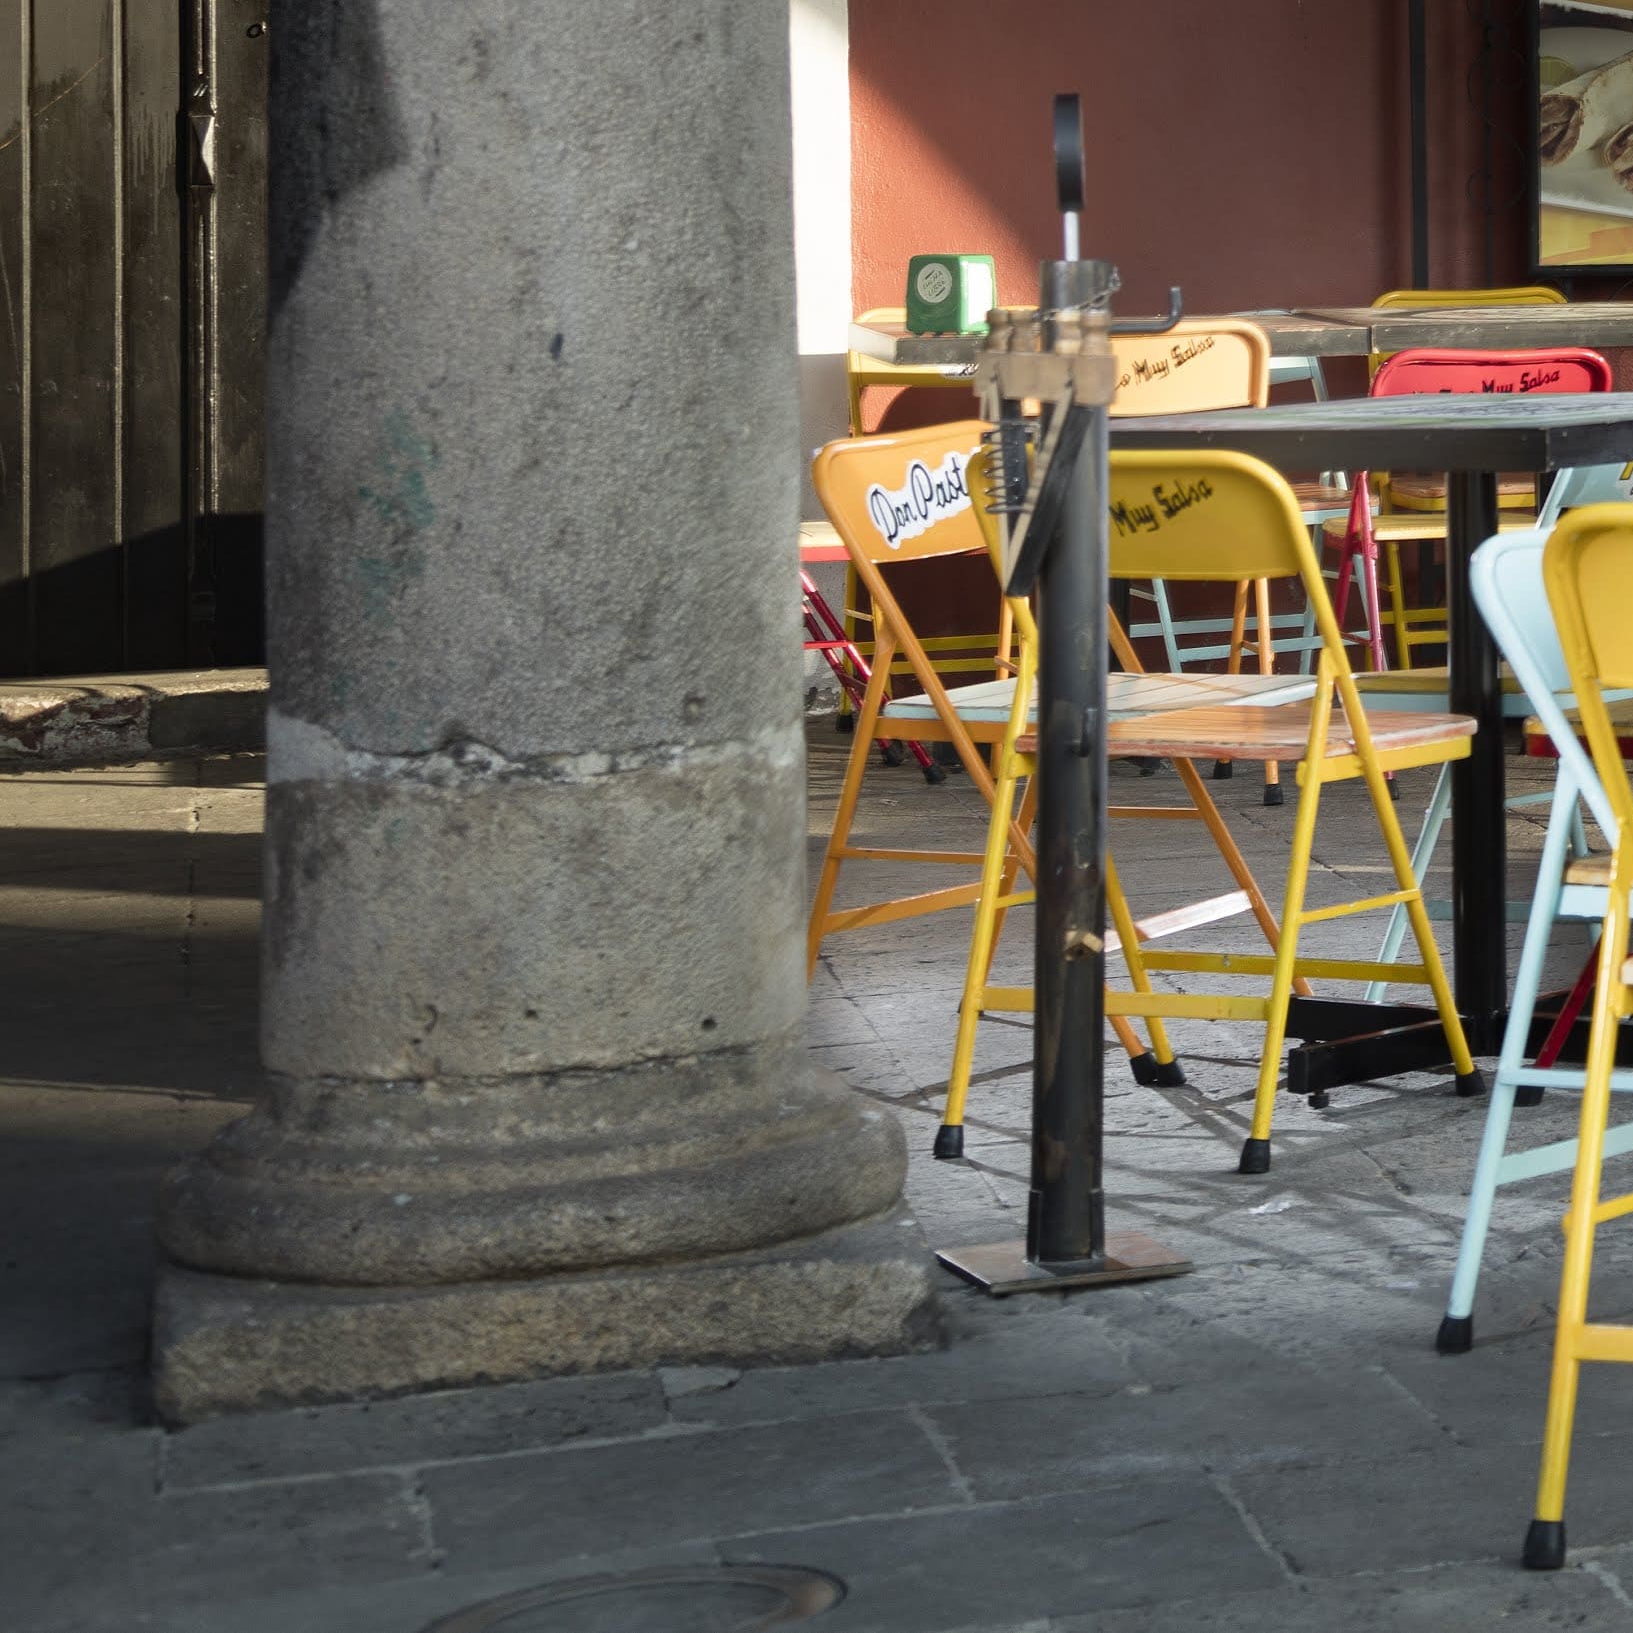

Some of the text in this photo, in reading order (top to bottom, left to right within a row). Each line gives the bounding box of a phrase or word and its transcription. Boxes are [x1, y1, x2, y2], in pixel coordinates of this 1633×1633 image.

[1170, 336, 1216, 368] Salsa
[1519, 368, 1561, 393] Salsa
[870, 453, 970, 543] Don Past
[1109, 477, 1214, 537] Muy Salsa
